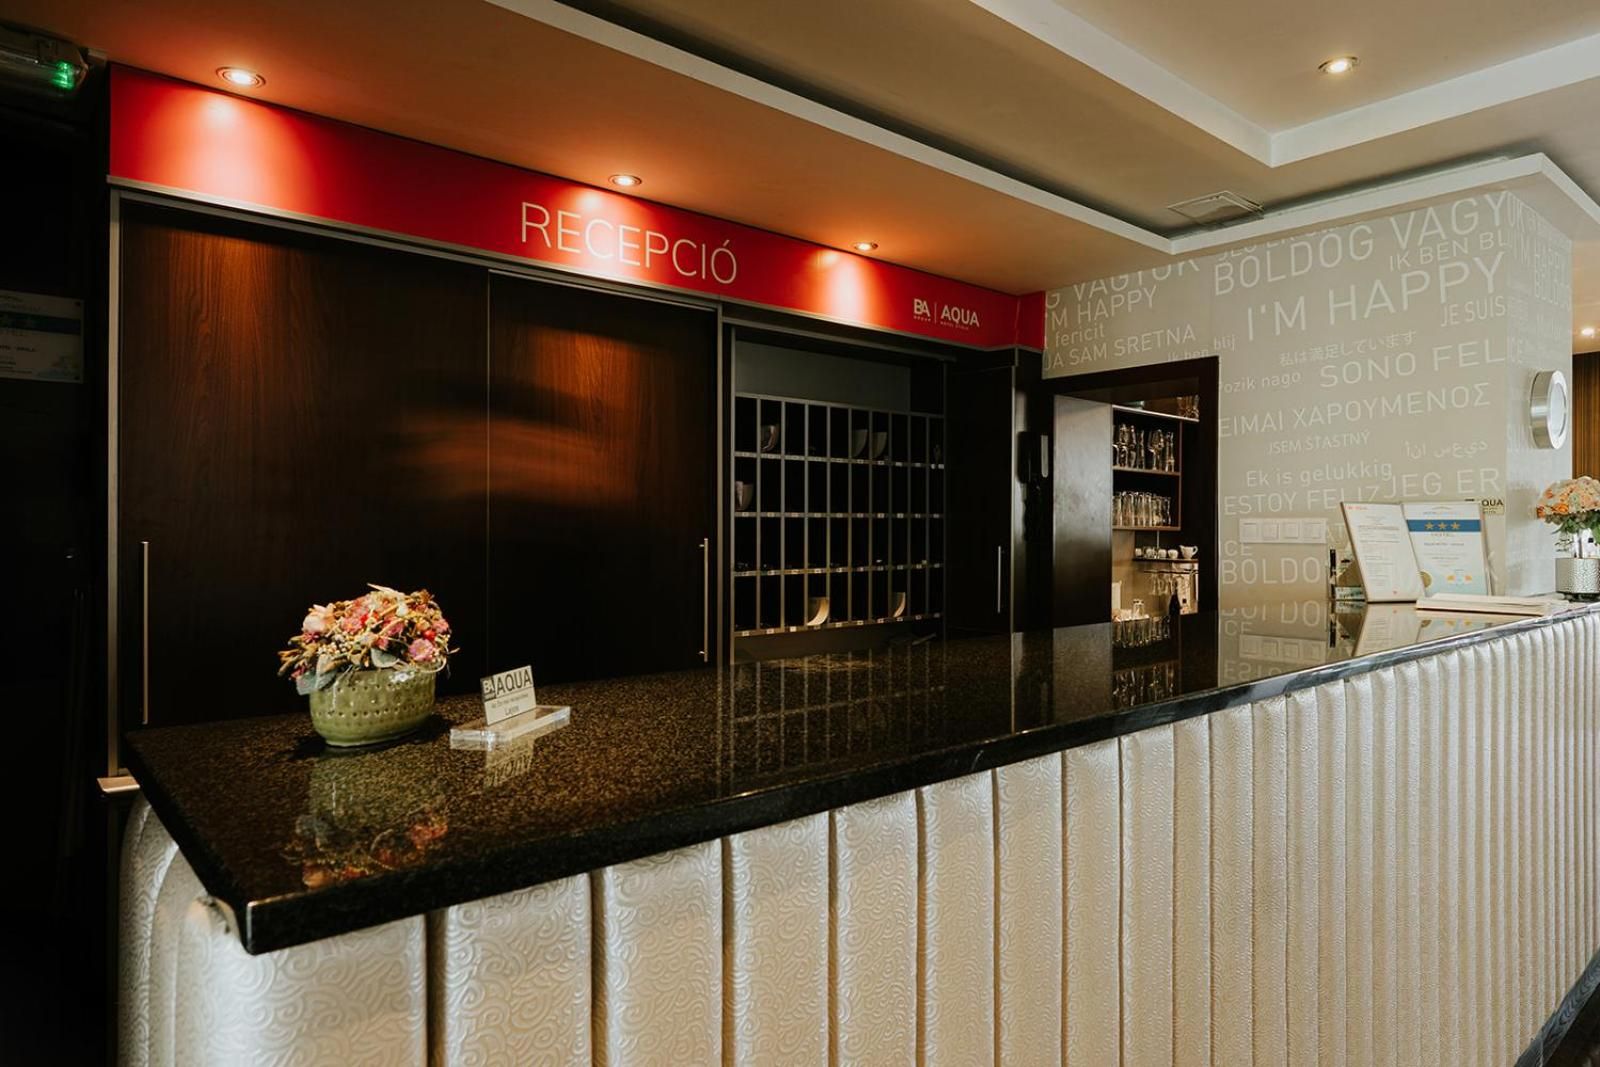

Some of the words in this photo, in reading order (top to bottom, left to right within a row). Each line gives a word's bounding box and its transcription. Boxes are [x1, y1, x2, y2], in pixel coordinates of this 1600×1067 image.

[520, 202, 738, 284] RECEPCIÓ
[1390, 253, 1412, 272] IK
[1419, 237, 1469, 265] BEN
[1215, 224, 1374, 296] BOLDOG
[1077, 285, 1157, 324] HAPPY
[1247, 296, 1306, 342] I'M
[1328, 251, 1506, 326] HAPPY
[1440, 304, 1460, 327] JE
[1464, 295, 1507, 323] SUIS
[940, 305, 980, 328] AQUA
[1055, 323, 1106, 348] fericit
[1069, 343, 1108, 367] SAM
[1114, 323, 1197, 357] SRETNA
[1221, 377, 1256, 393] ozik
[1261, 372, 1301, 390] nago
[1320, 352, 1417, 388] SONO
[1246, 469, 1271, 487] Ek
[1277, 467, 1293, 485] is
[1300, 458, 1393, 486] gelukkig
[1383, 471, 1442, 499] JEG
[1456, 467, 1500, 495] ER
[1223, 491, 1297, 516] ESTOY
[496, 668, 533, 696] AQUA
